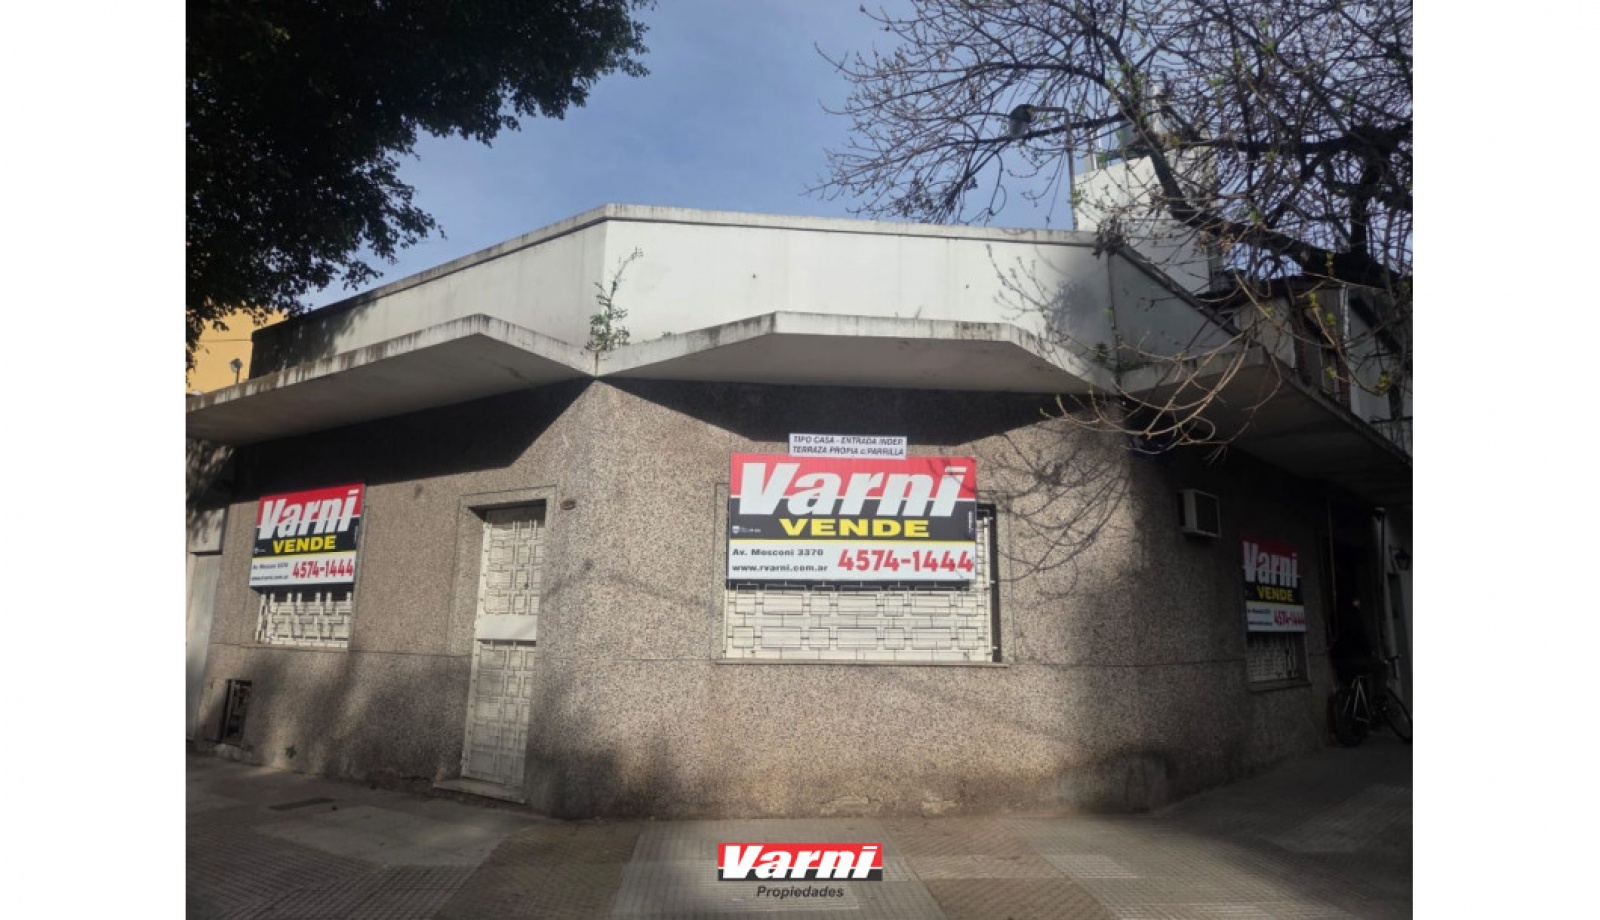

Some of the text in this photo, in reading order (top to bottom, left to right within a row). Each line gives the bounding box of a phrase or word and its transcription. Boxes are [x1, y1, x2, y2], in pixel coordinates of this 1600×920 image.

[793, 435, 811, 443] TIPO
[813, 436, 834, 444] CASA
[840, 437, 877, 445] ENTRADA
[793, 446, 827, 454] TERRAZA
[830, 446, 858, 455] PROPIA
[867, 447, 904, 456] PARRILLA
[739, 462, 967, 517] Varni
[258, 489, 359, 539] Varni
[779, 518, 930, 538] VENDE
[272, 534, 337, 553] VENDE
[732, 548, 748, 556] Av.
[751, 548, 795, 557] Mosconi
[292, 558, 354, 579] 4574-1444
[732, 564, 829, 573] www.rvarni.com.ar
[837, 549, 974, 572] 4574-1444
[1243, 541, 1298, 588] Varni
[1257, 585, 1293, 601] VENDE
